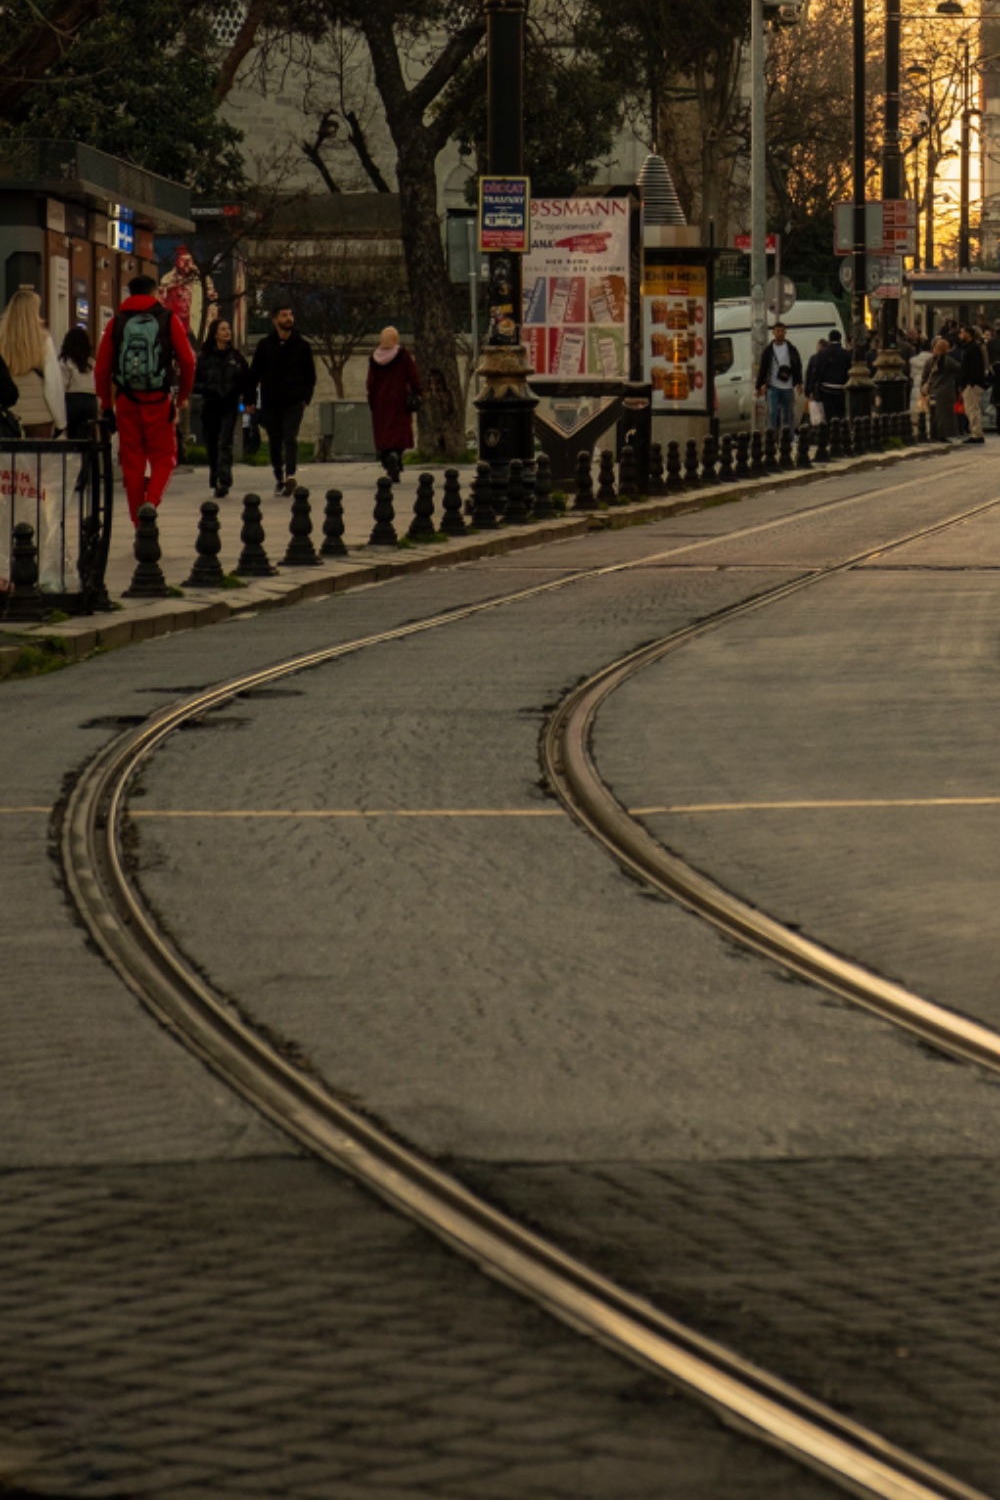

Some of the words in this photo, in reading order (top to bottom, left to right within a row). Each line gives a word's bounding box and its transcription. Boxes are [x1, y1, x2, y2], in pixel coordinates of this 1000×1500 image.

[484, 182, 524, 193] DİKKAT
[484, 196, 525, 204] TRAMVAY
[530, 200, 626, 217] OSSMANN
